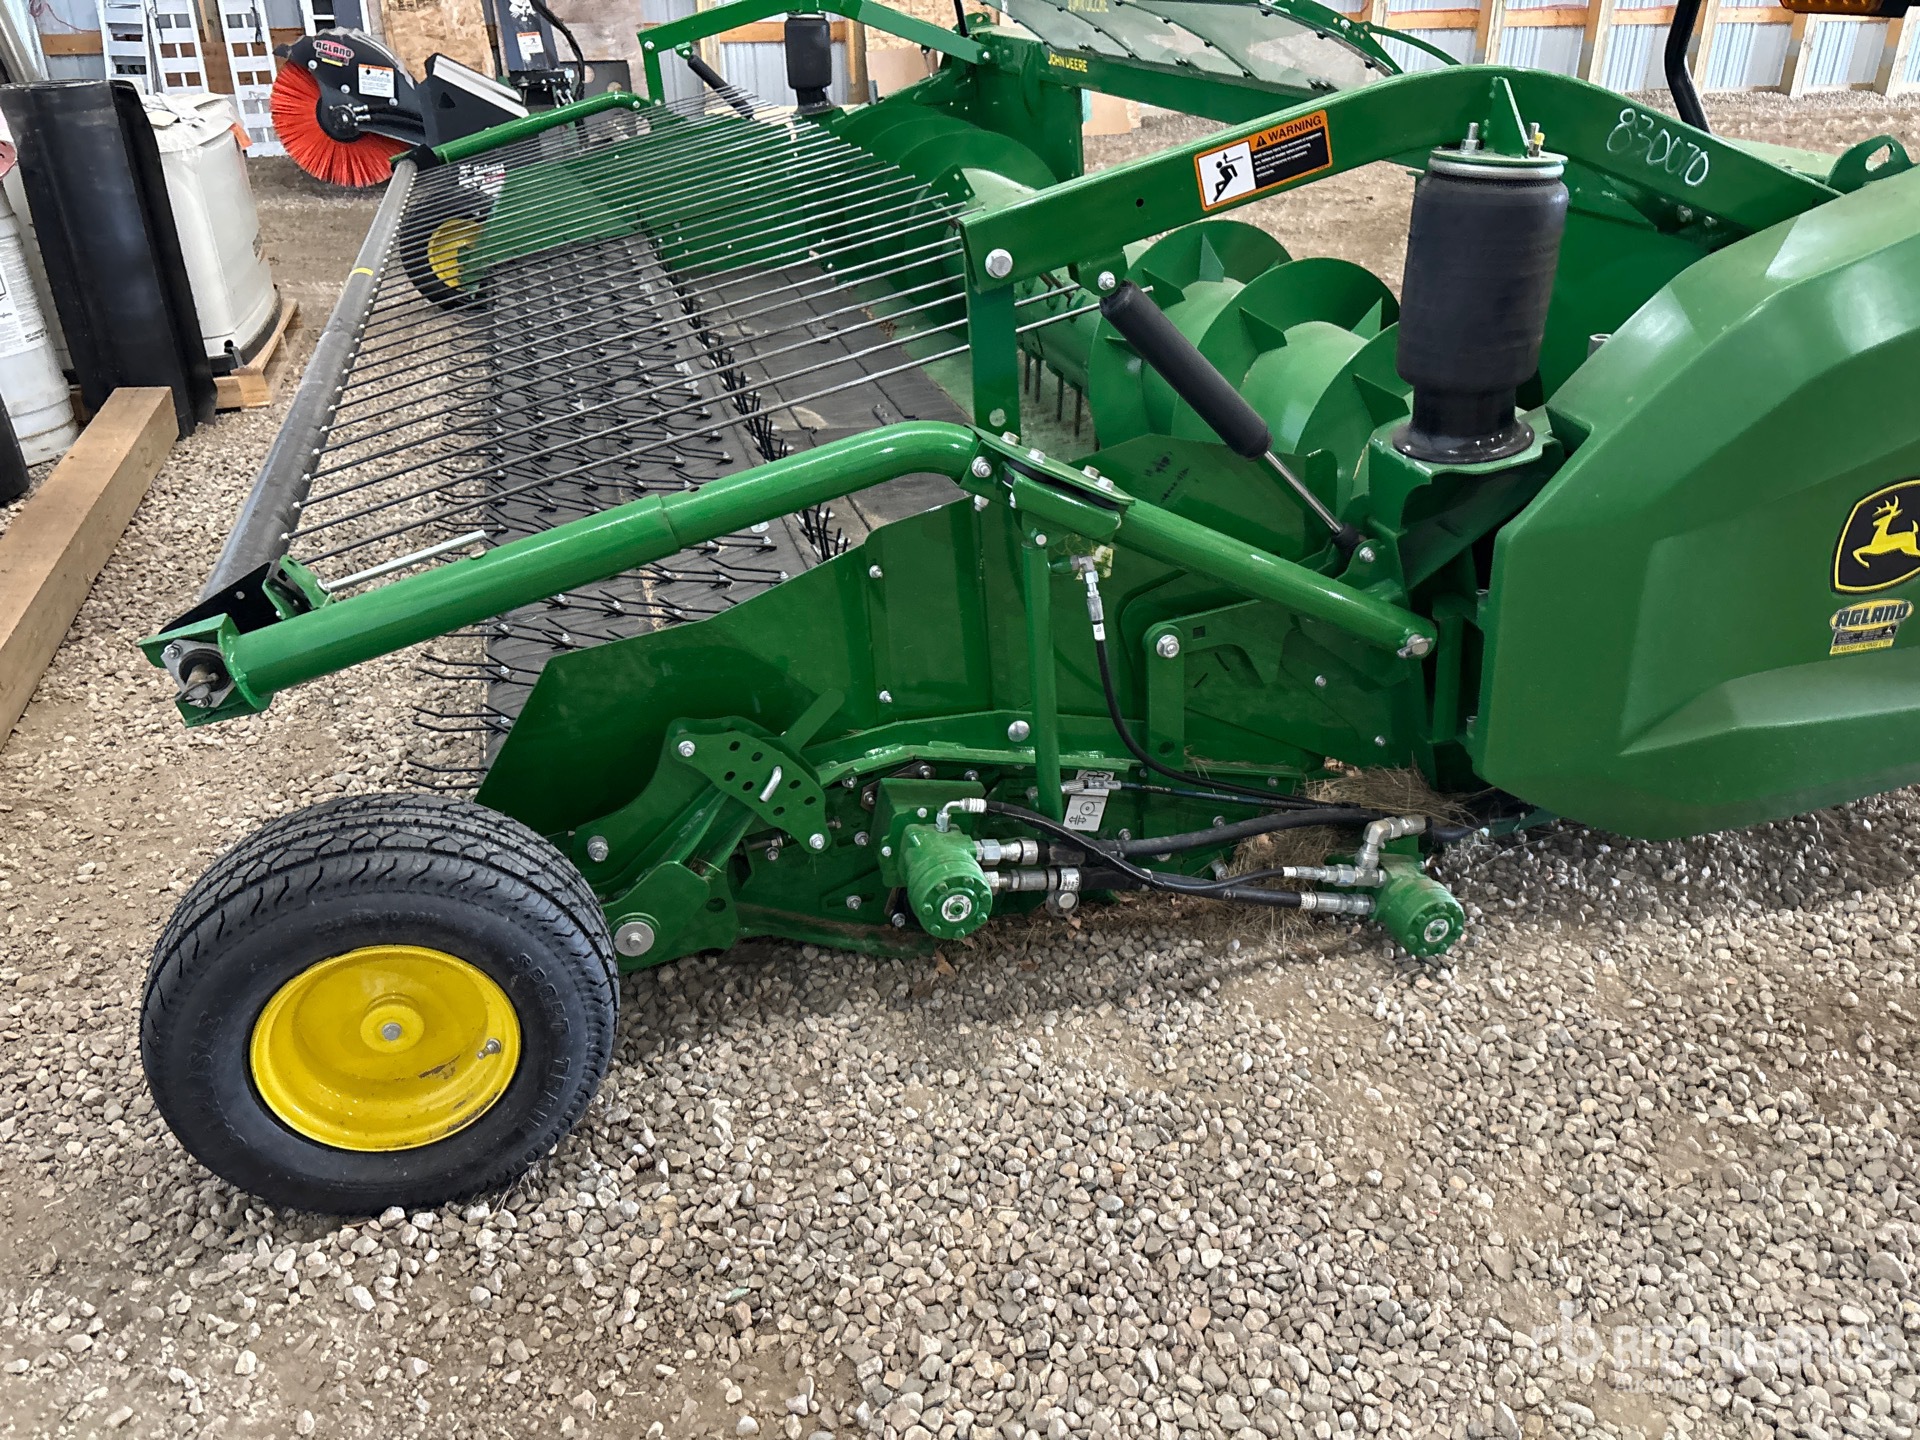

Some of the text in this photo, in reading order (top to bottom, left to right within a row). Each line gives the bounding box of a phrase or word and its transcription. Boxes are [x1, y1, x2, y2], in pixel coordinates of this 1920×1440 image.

[316, 41, 352, 58] AGLAND
[1048, 51, 1088, 73] JOHN DEERE
[1267, 115, 1322, 142] WARNING
[1606, 107, 1710, 187] 830070
[1835, 603, 1909, 627] AGLAND
[524, 1056, 571, 1129] TRAIL
